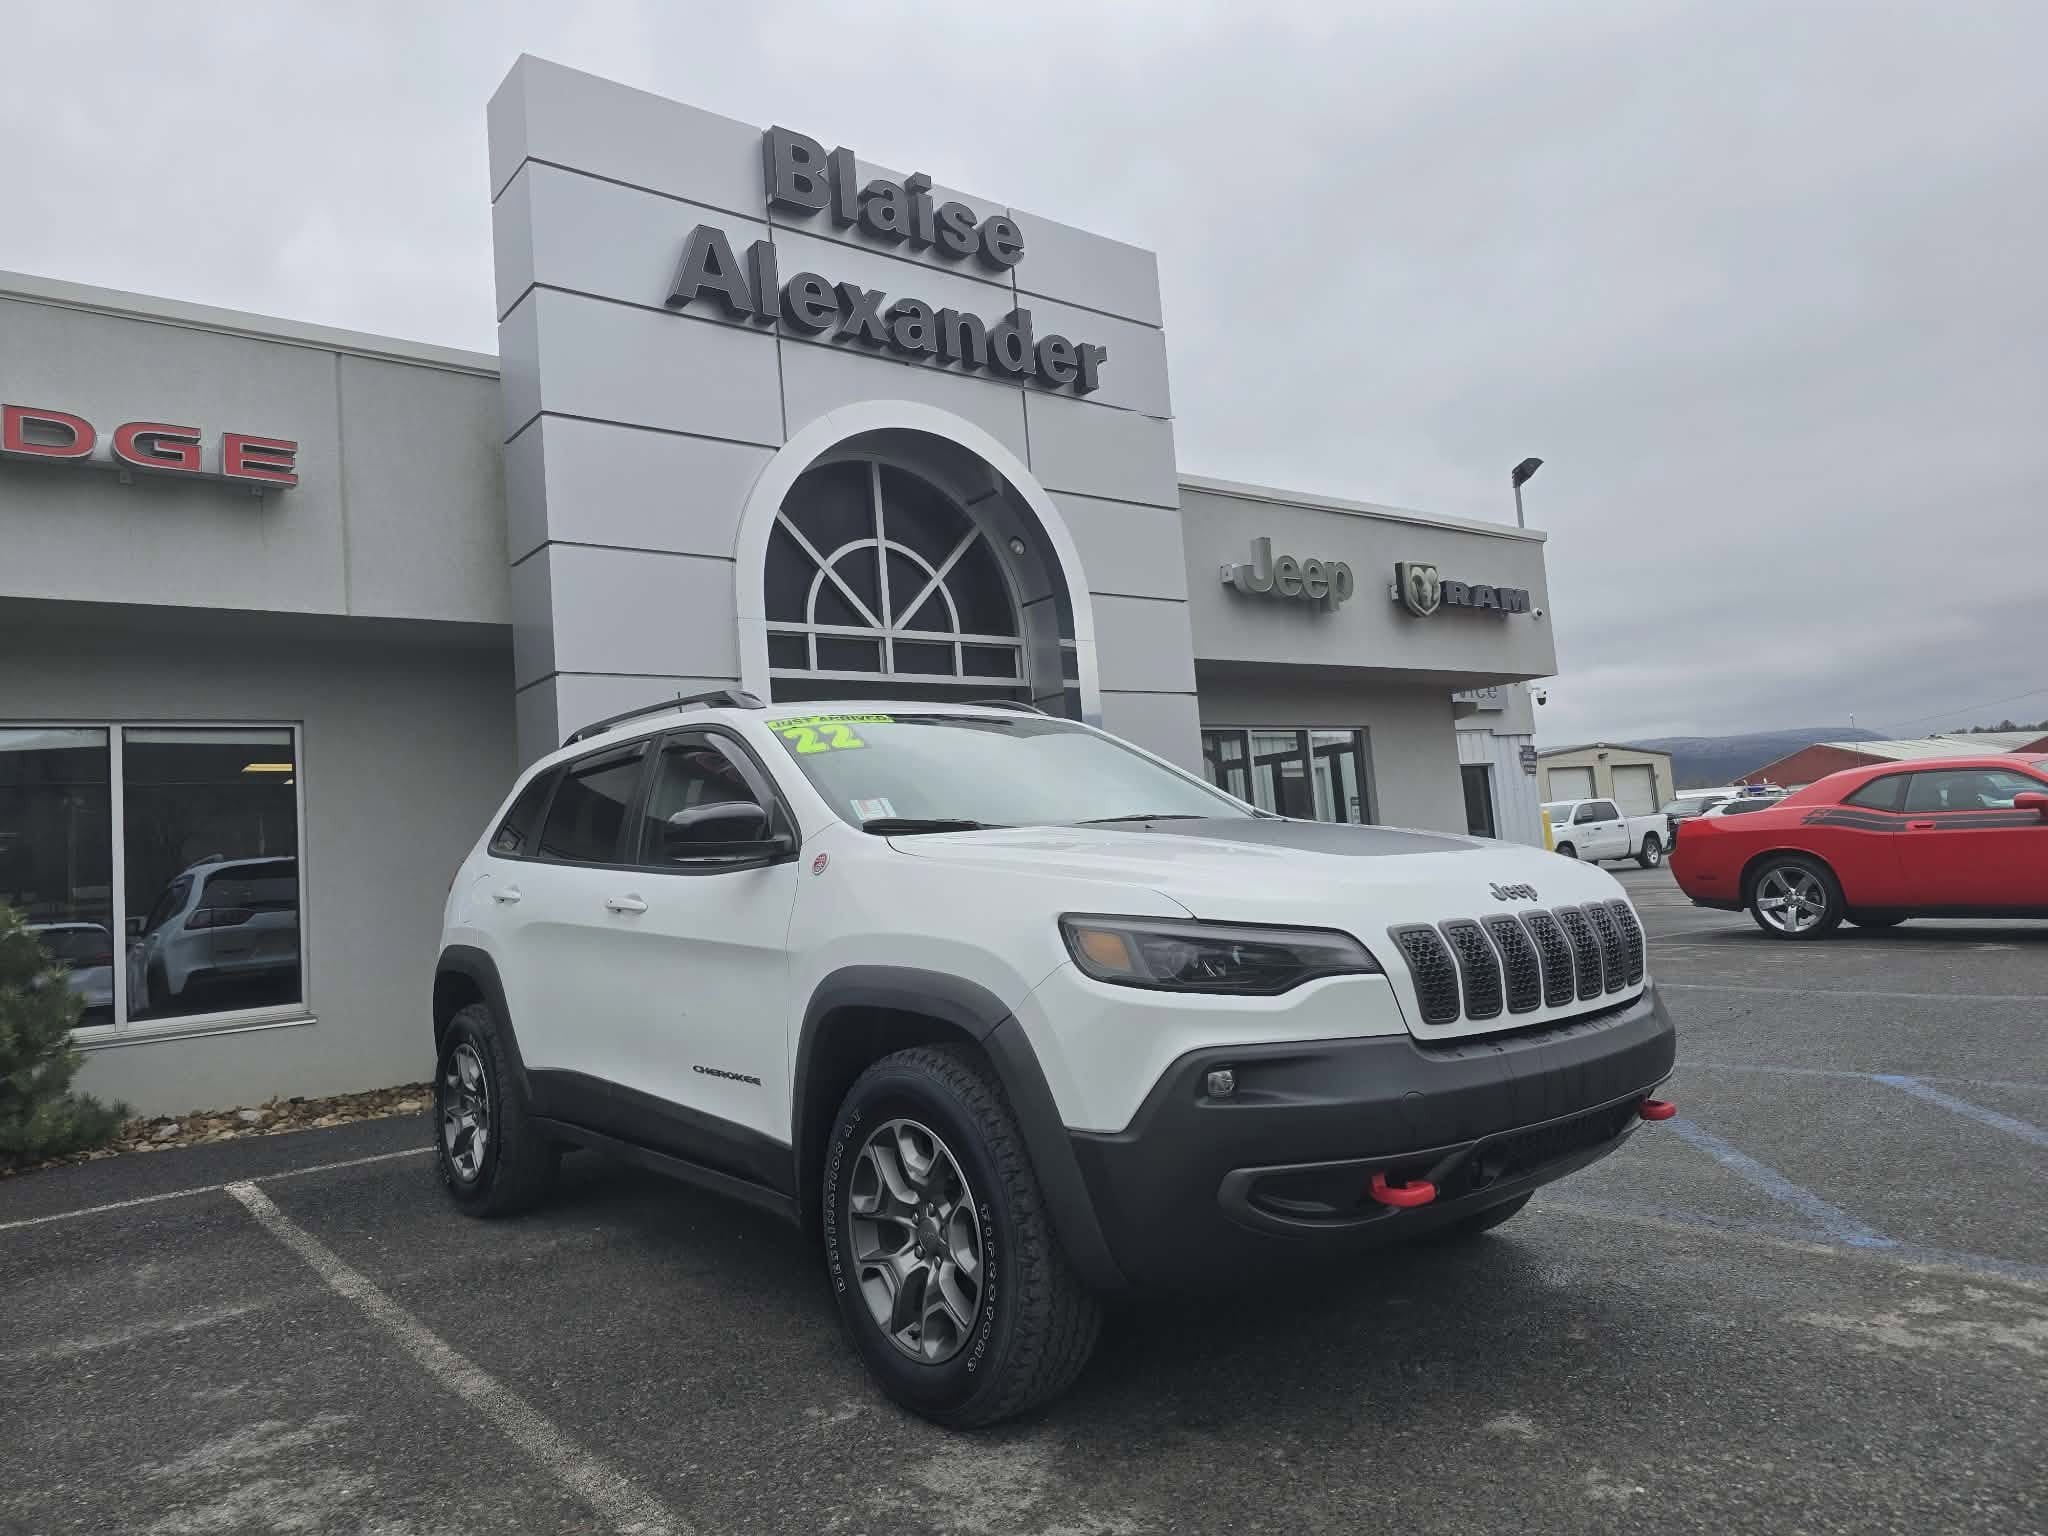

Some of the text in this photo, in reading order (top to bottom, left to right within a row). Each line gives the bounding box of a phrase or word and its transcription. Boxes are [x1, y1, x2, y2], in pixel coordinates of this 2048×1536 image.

[763, 125, 1025, 271] Blaise
[665, 224, 1107, 394] Alexander
[1230, 536, 1354, 612] Jeep
[1440, 579, 1530, 614] RAM
[783, 725, 864, 753] 22
[1489, 882, 1538, 901] Jeep
[693, 1065, 761, 1086] CHEROKEE
